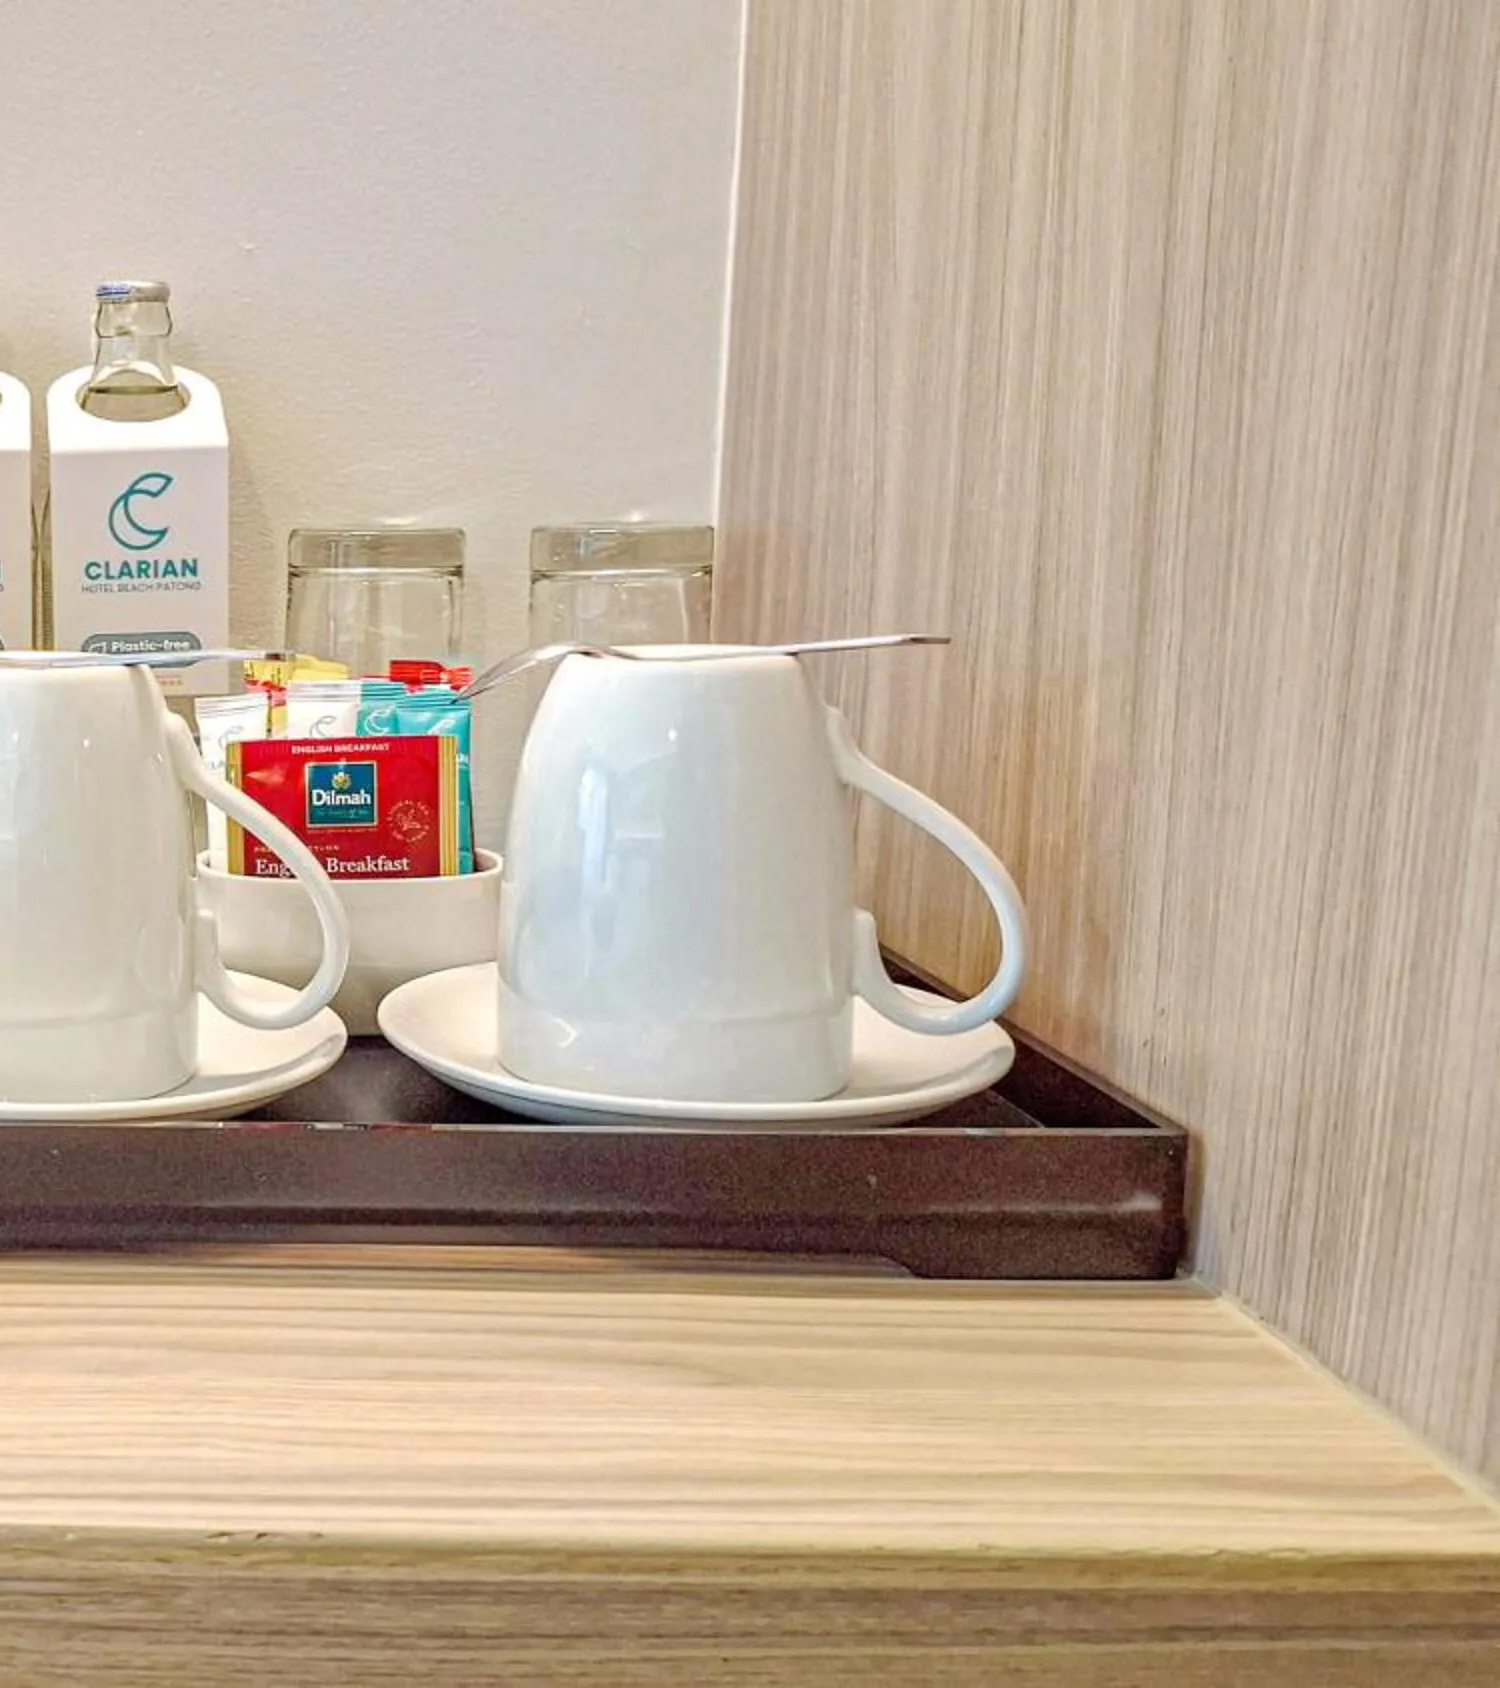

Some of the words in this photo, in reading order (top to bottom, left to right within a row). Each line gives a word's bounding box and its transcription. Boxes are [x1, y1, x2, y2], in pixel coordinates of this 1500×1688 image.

[84, 558, 199, 580] CLARIAN
[81, 583, 113, 593] HOTEL
[117, 582, 153, 593] BEACH
[156, 581, 203, 591] PATONG
[111, 639, 191, 654] Plastic-free
[291, 745, 333, 754] ENGLISH
[334, 743, 390, 753] BREAKFAST
[311, 788, 371, 806] Dilmah
[326, 855, 410, 873] Breakfast
